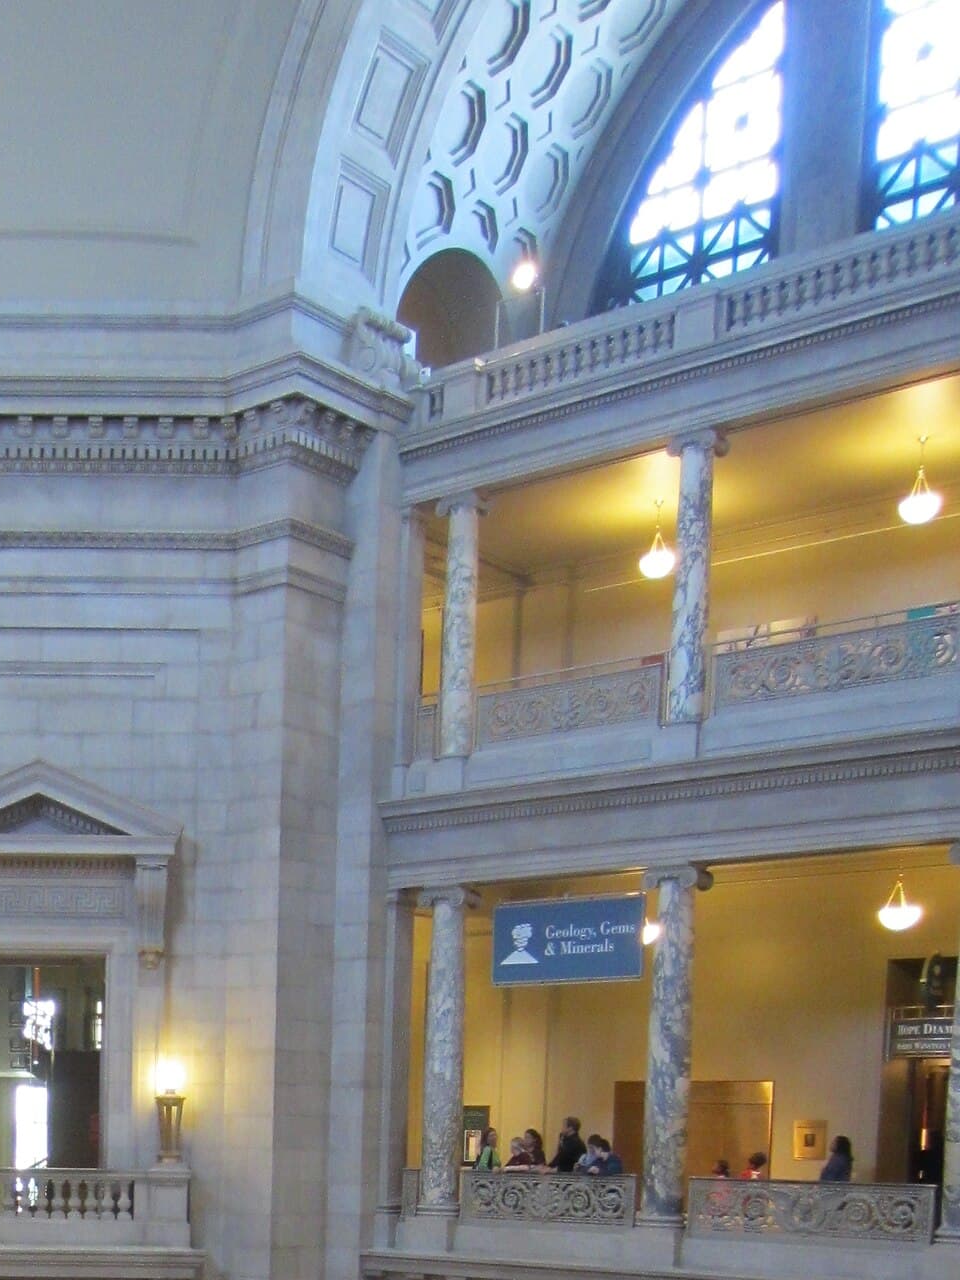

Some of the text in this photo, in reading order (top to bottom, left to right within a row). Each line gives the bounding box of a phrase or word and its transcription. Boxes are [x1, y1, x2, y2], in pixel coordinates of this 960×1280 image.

[545, 921, 636, 940] Geology, Gems
[544, 939, 615, 956] & Minerals
